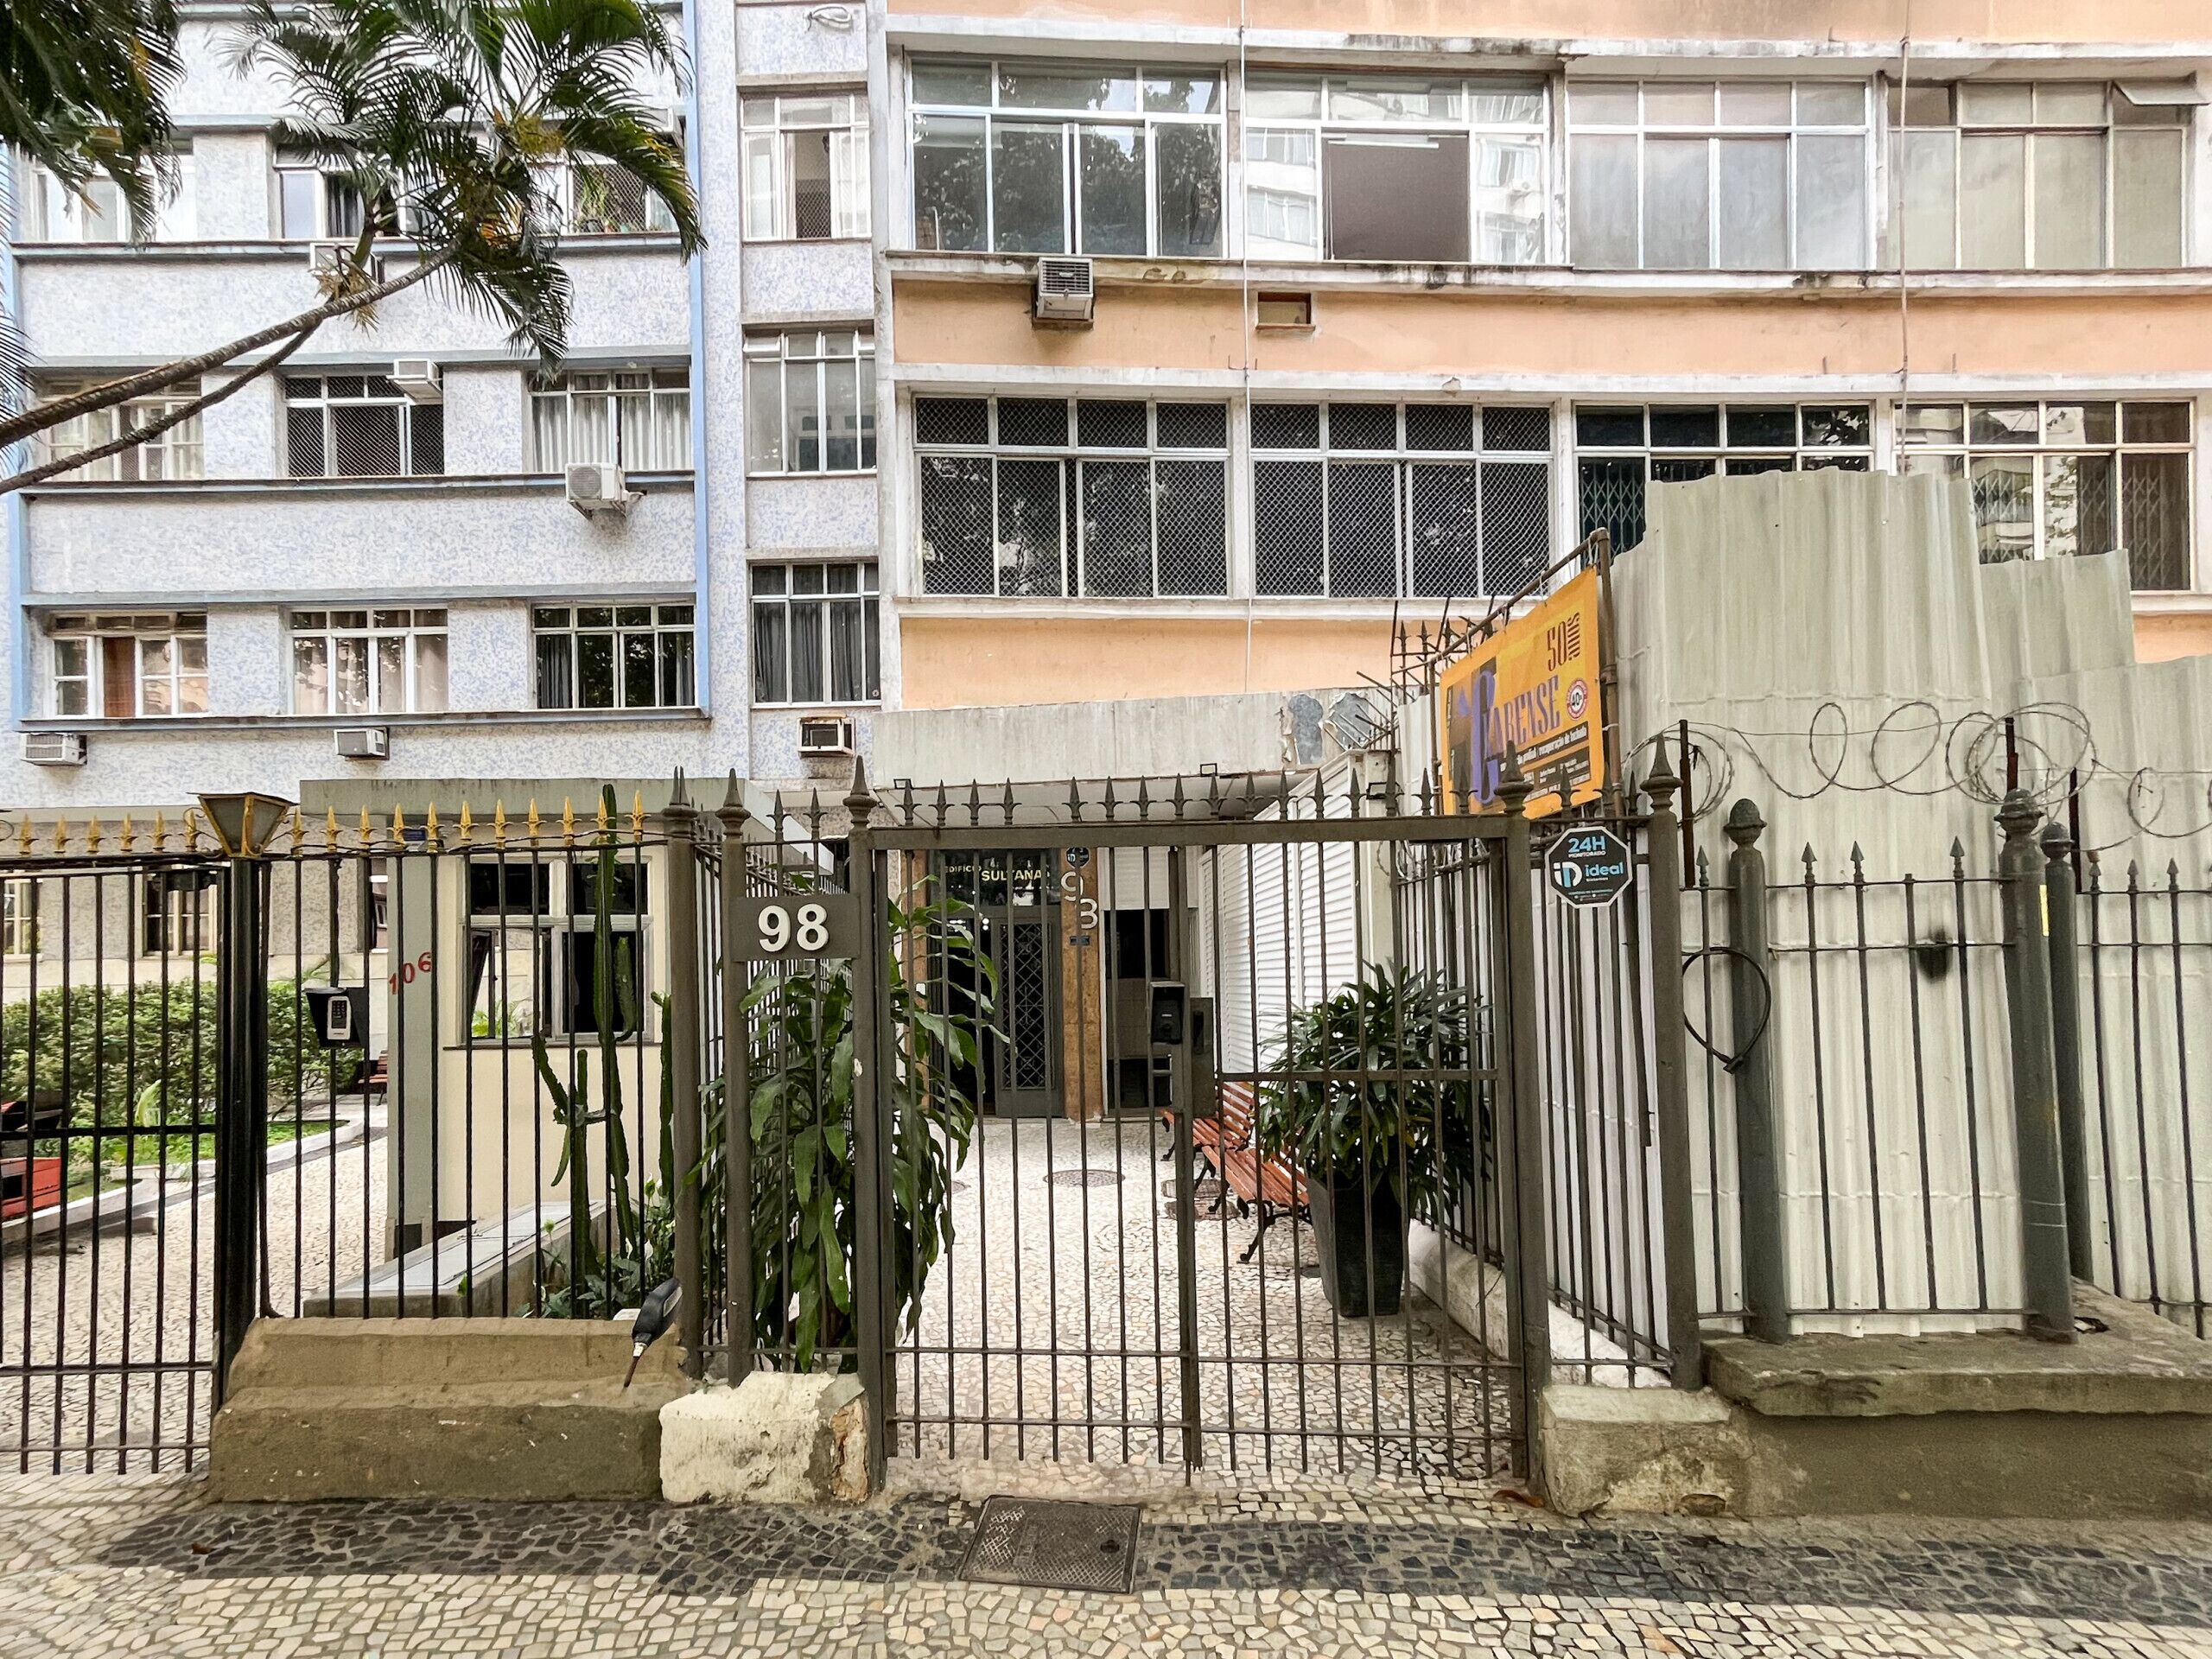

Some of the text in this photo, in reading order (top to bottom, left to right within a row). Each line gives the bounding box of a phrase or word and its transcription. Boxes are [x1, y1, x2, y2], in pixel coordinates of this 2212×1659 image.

[1547, 620, 1567, 672] 50
[1568, 836, 1605, 853] 24H
[1585, 861, 1624, 877] ideal
[758, 903, 830, 952] 98
[389, 951, 432, 995] 106
